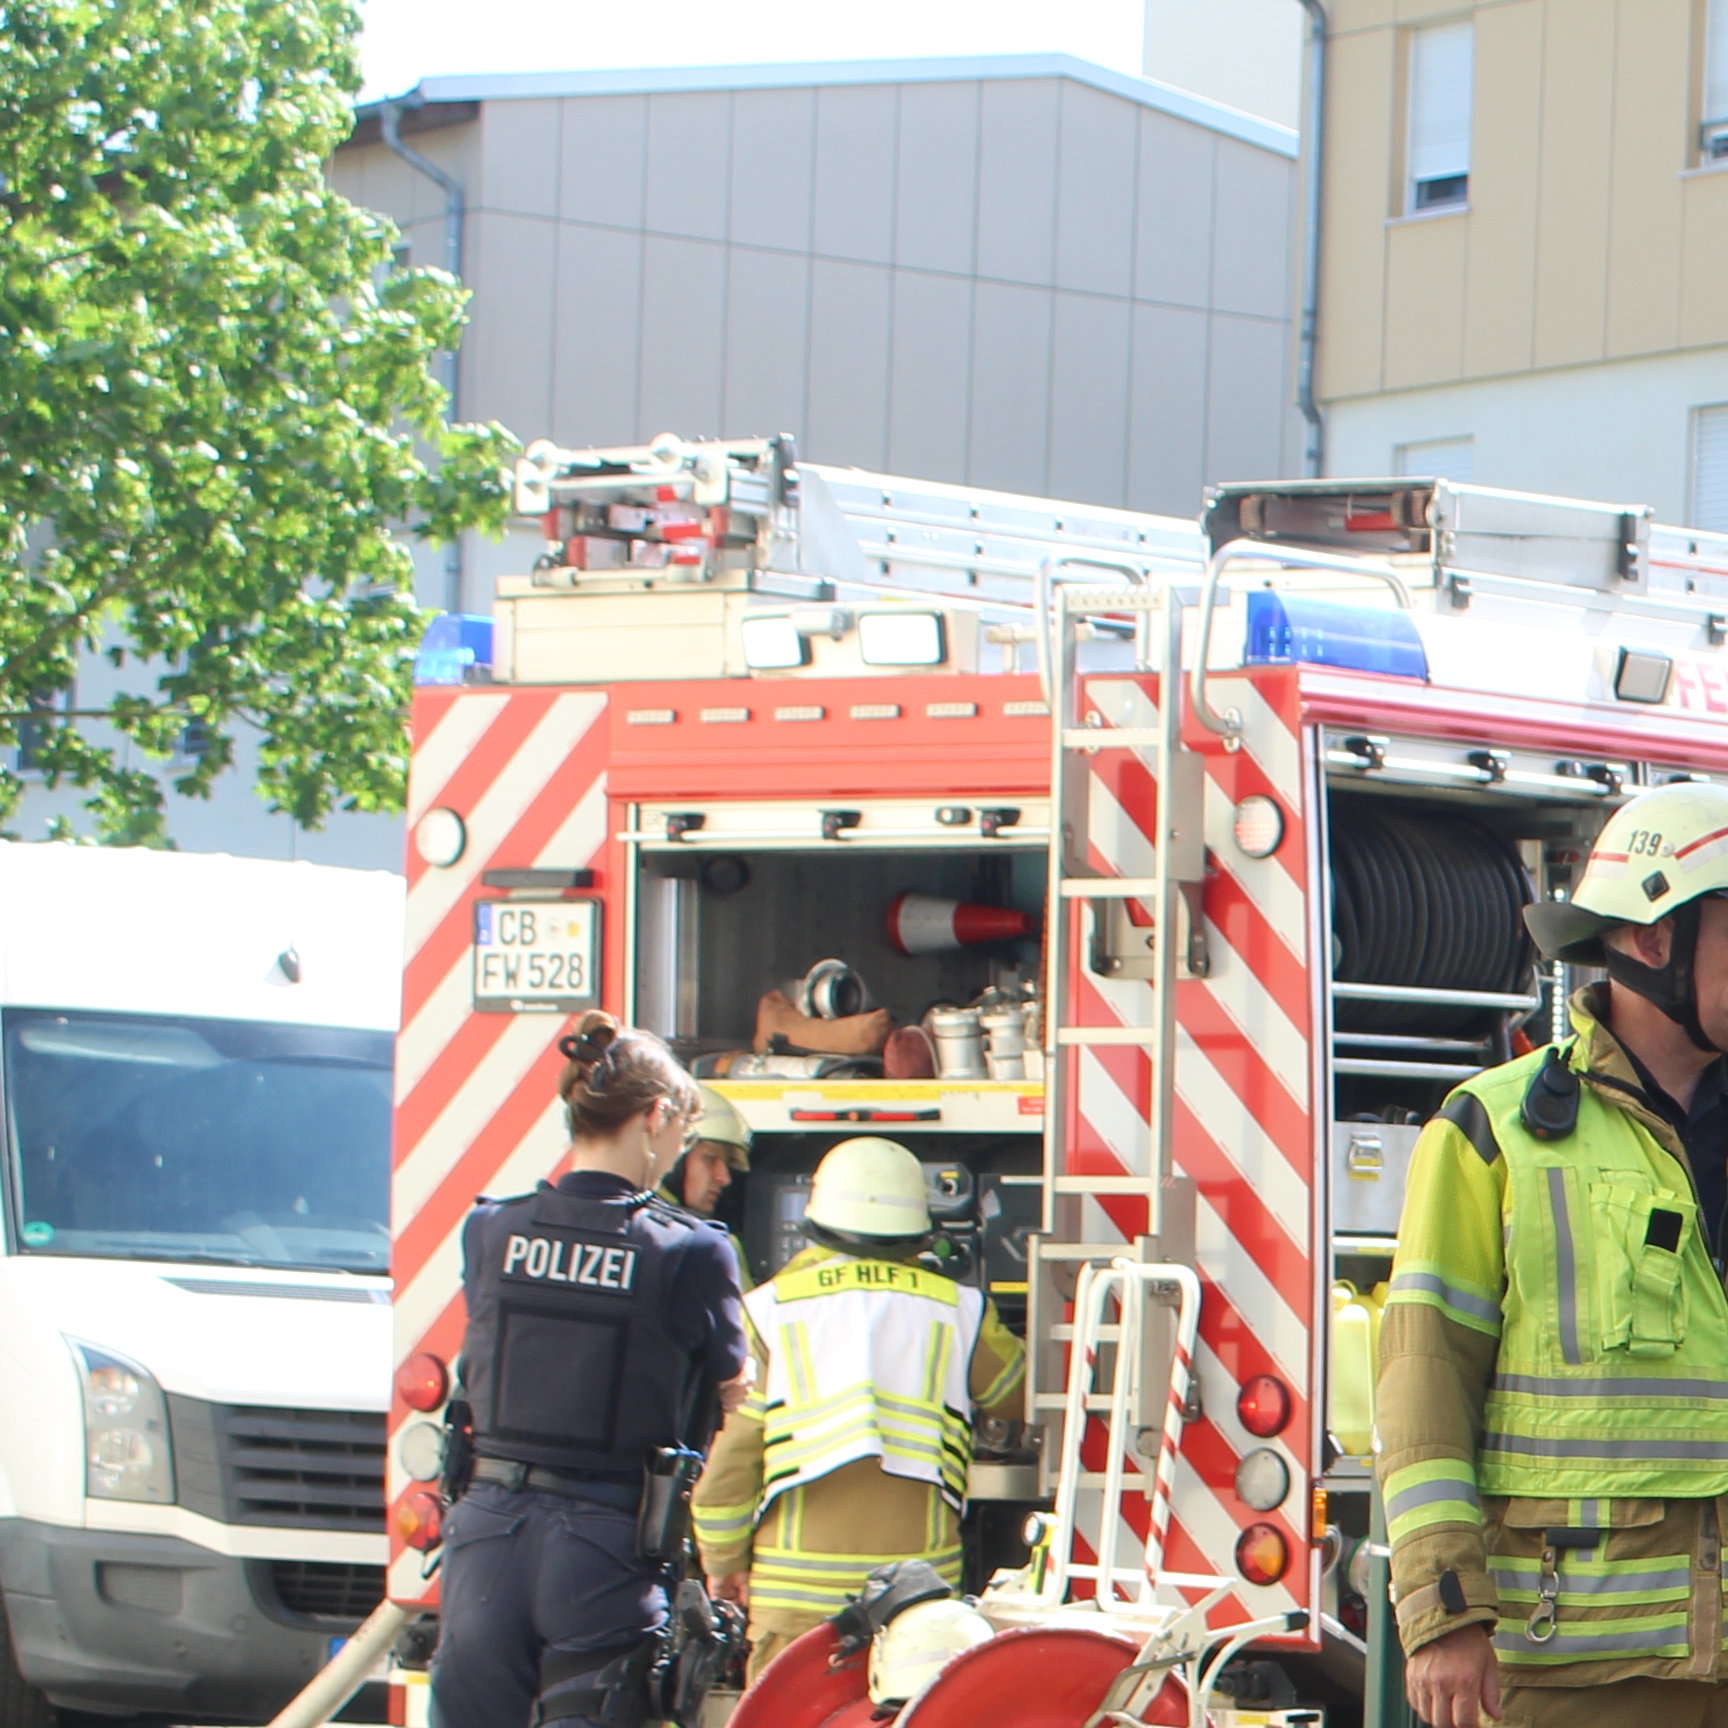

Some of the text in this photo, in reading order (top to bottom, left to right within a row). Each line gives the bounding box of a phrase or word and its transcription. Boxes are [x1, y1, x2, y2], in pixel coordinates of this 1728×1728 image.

[1627, 829, 1662, 857] 139
[499, 909, 537, 946] CB
[483, 952, 584, 989] FW 528
[502, 1234, 637, 1290] POLIZEI
[817, 1266, 847, 1288] GF
[856, 1264, 900, 1285] HLF
